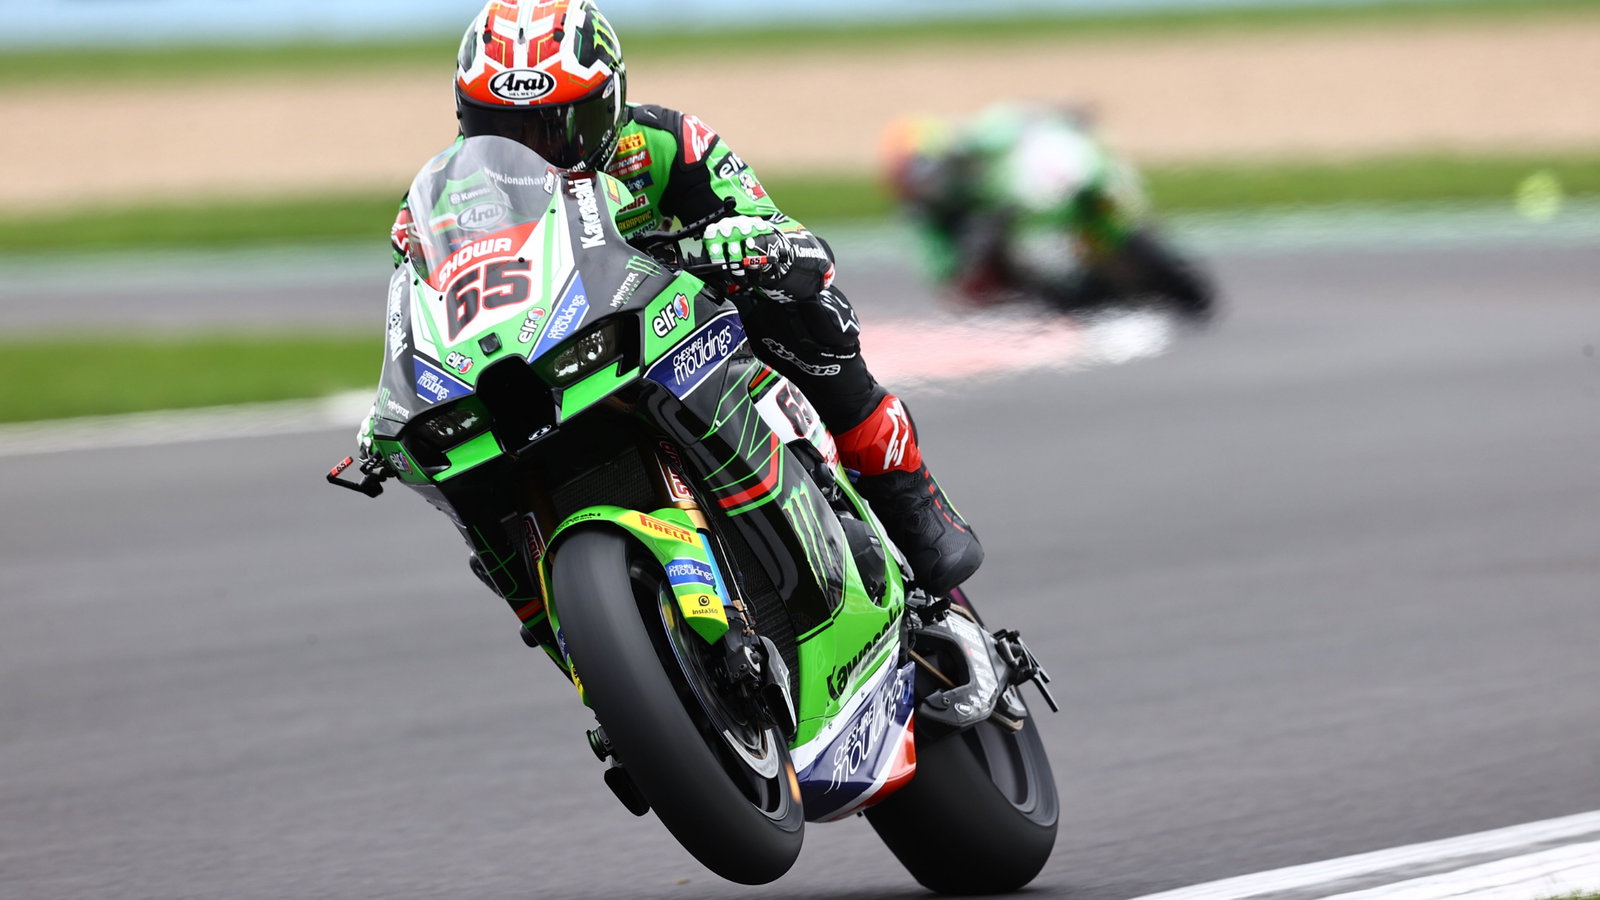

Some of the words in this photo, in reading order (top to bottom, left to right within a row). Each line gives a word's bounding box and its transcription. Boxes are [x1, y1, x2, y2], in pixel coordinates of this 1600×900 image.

[495, 73, 545, 91] Arai
[719, 152, 745, 179] elf
[466, 206, 499, 224] Arai
[568, 177, 606, 249] Kawasaki
[438, 237, 512, 290] SHOWA
[446, 259, 533, 342] 65
[609, 272, 640, 308] MONSTER
[389, 269, 408, 362] Kawasaki
[518, 318, 539, 344] elf
[652, 304, 677, 337] elf
[447, 351, 464, 369] elf
[672, 337, 702, 366] CHESHIRE
[674, 325, 732, 386] mouldings
[639, 514, 693, 544] PIRELLI
[669, 565, 714, 581] mouldings
[826, 604, 903, 702] Kawasaki
[824, 668, 906, 795] mouldings
[833, 703, 875, 766] CHESHIRE
